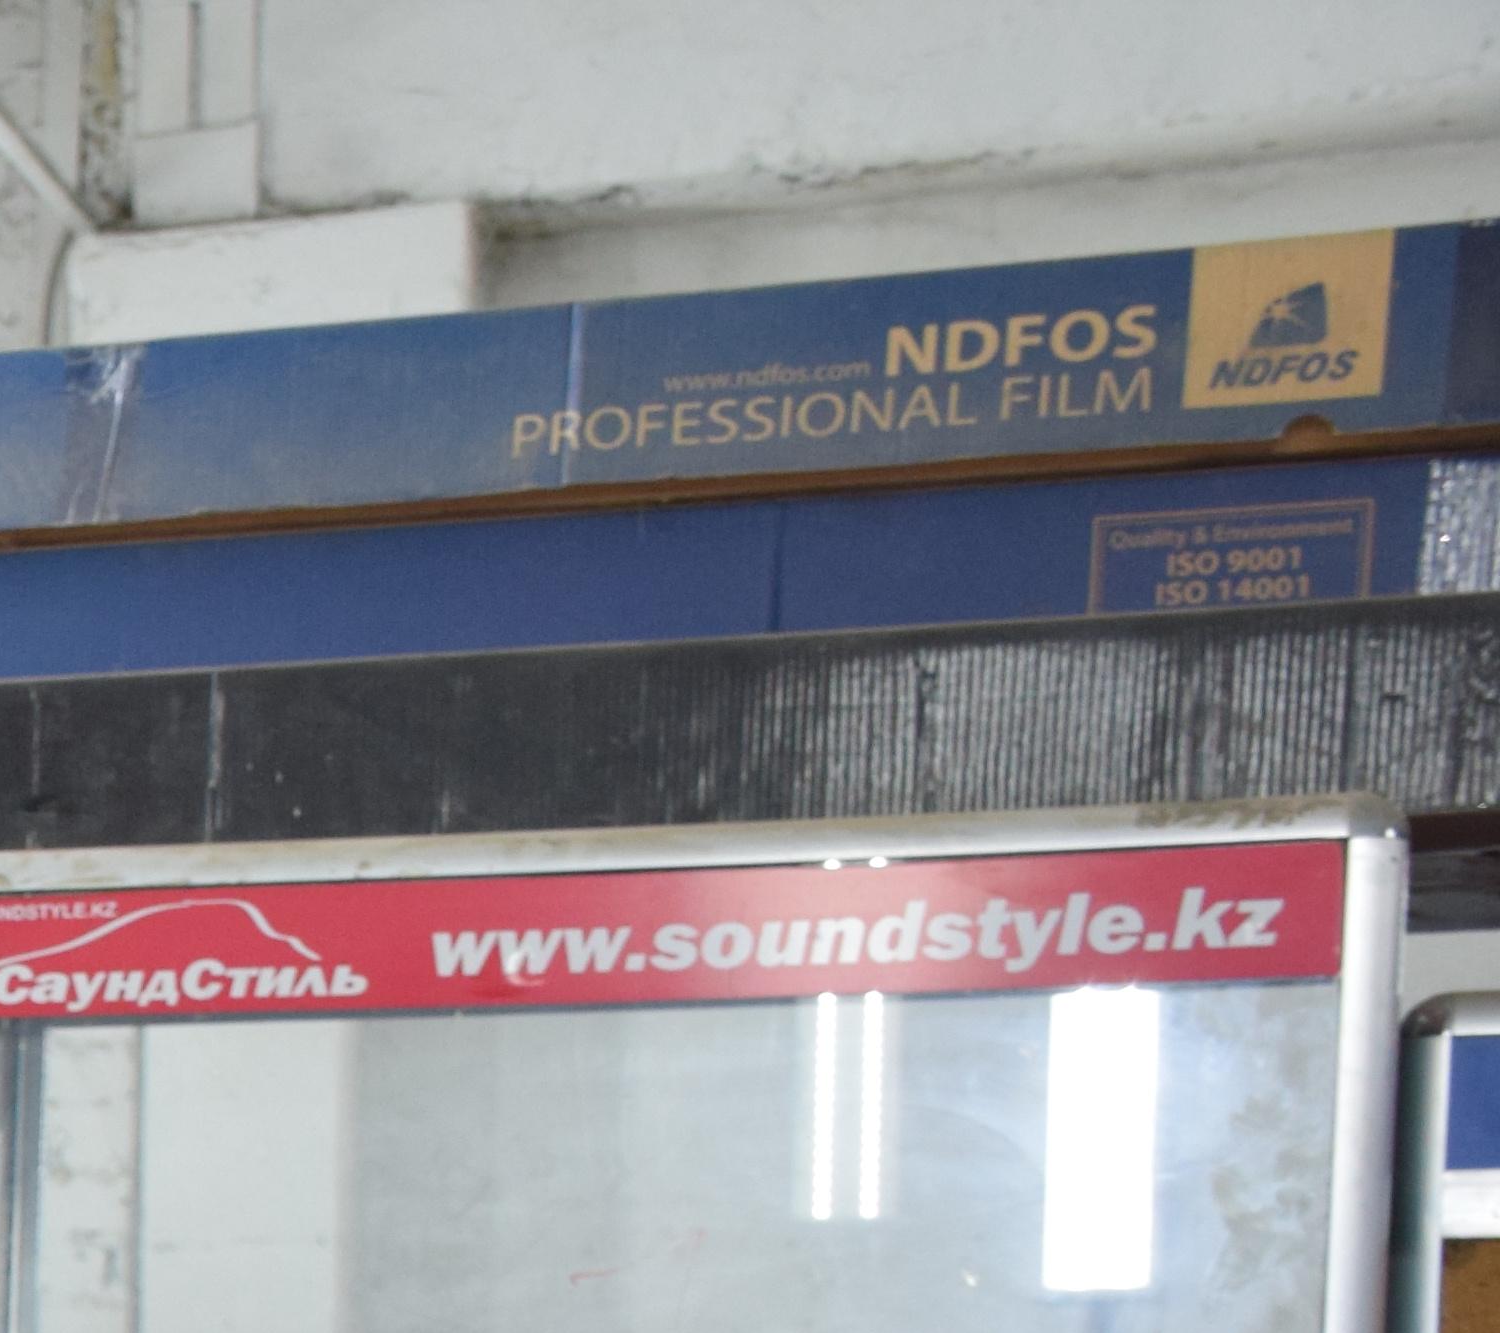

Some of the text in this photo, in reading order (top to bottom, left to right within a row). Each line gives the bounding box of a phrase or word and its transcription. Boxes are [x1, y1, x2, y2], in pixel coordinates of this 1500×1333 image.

[654, 305, 1158, 393] www.ndfos.com NDFOS
[1209, 350, 1359, 390] NDFOS
[510, 367, 1154, 459] PROFESSIONAL FILM
[1156, 573, 1310, 606] ISO 14001
[1167, 546, 1303, 577] ISO 9001
[431, 887, 1284, 977] www.soundstyle.kz
